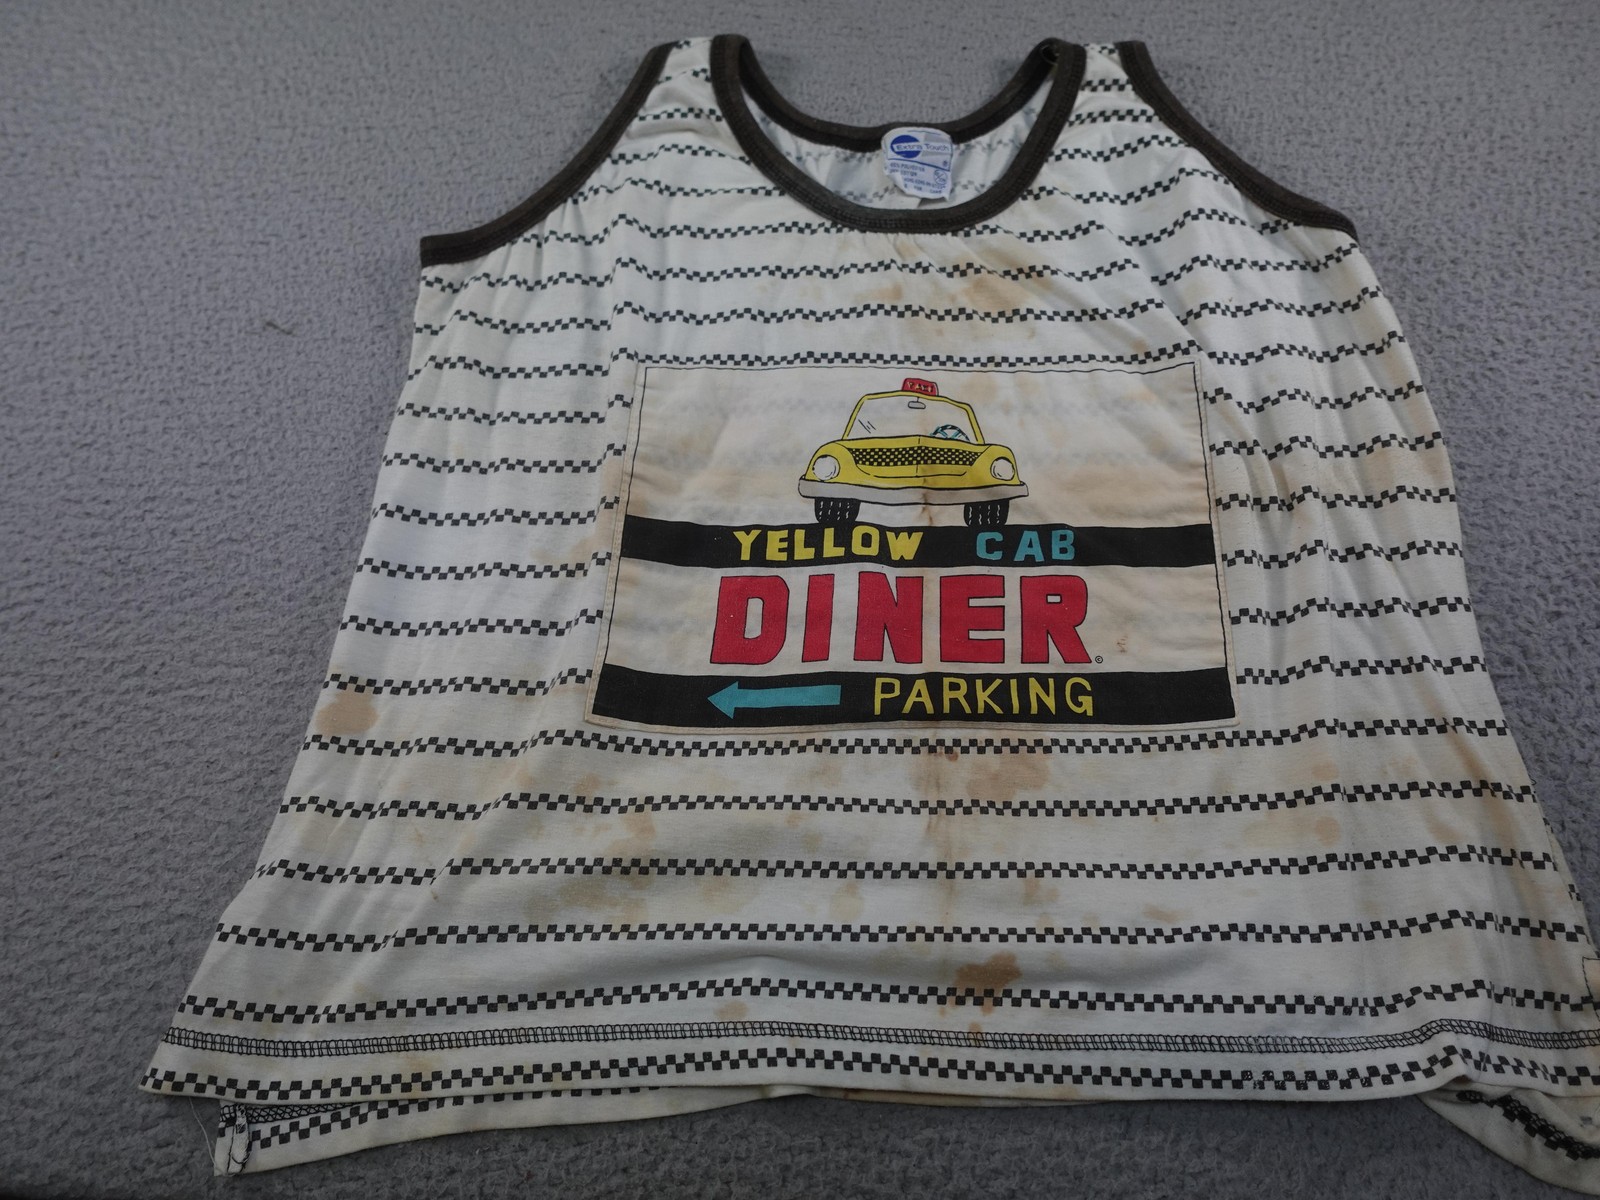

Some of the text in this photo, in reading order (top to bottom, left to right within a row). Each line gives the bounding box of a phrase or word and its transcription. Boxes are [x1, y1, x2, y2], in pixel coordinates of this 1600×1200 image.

[924, 143, 950, 152] Touch
[734, 527, 1075, 562] YELLOW CAB
[710, 571, 1092, 665] DINER
[873, 677, 1095, 717] PARKING
